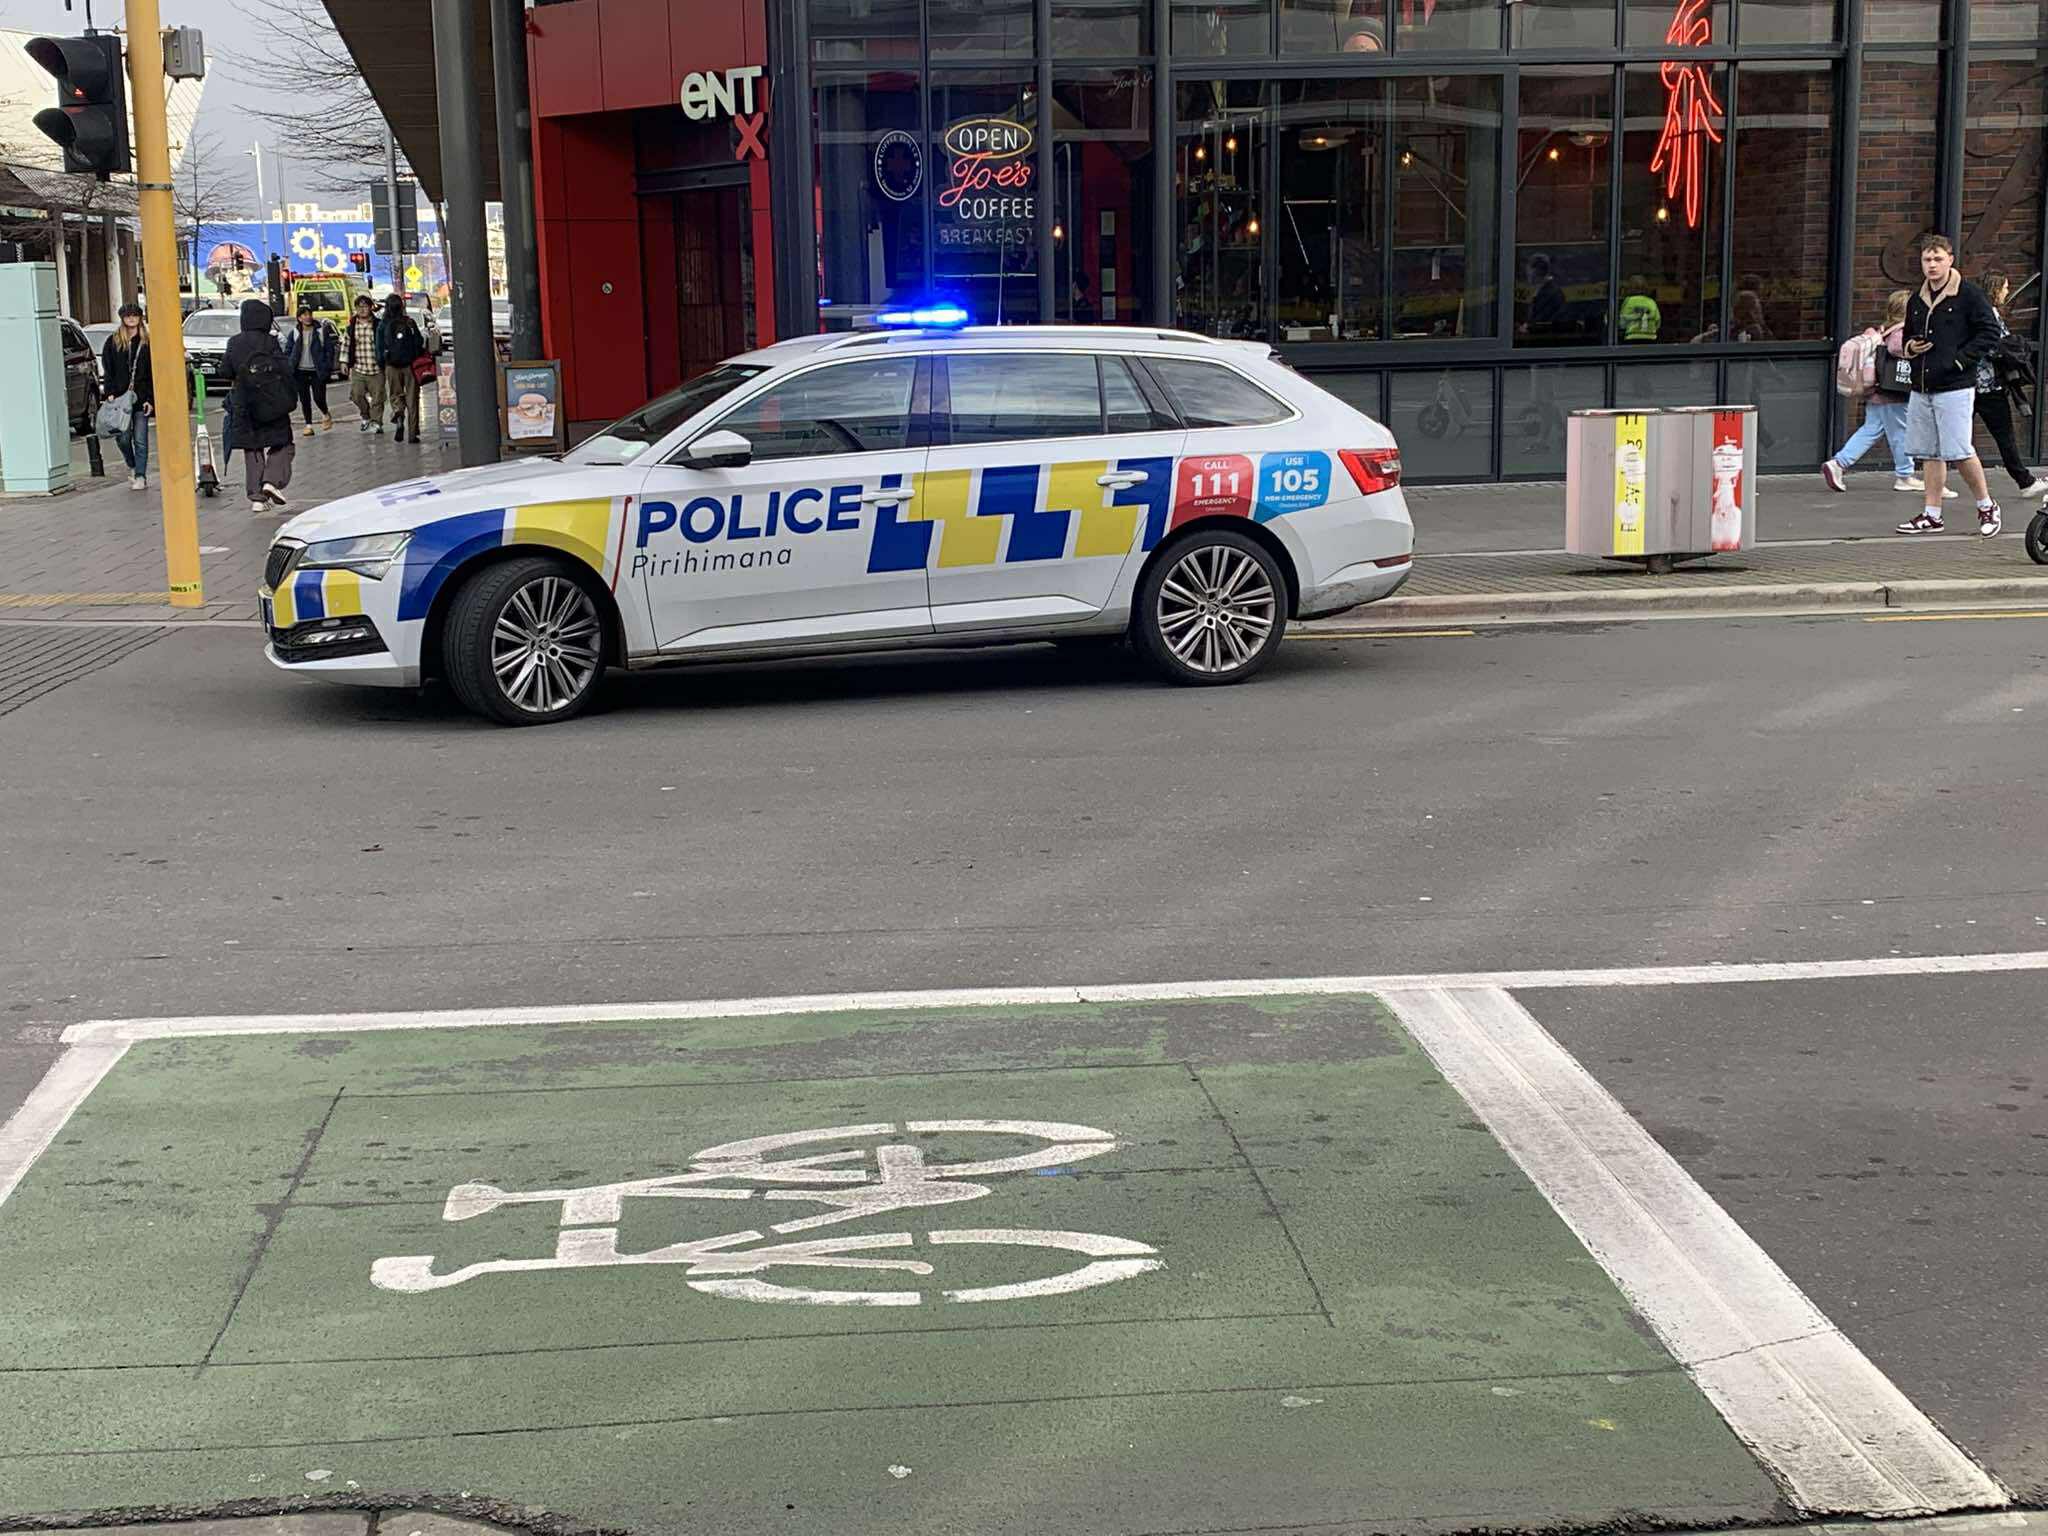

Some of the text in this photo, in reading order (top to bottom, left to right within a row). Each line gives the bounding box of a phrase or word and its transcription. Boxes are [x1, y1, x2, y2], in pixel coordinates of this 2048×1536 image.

[959, 128, 1018, 151] OPEN
[939, 151, 1031, 207] Joe's
[959, 198, 1035, 219] COFFEE
[940, 227, 1033, 245] BREAKFAST
[1204, 460, 1229, 470] CALL
[1285, 456, 1304, 466] USE
[1191, 471, 1239, 497] 111
[1271, 468, 1319, 493] 105
[1193, 497, 1238, 507] EMERGENCY
[635, 484, 864, 548] POLICE
[631, 548, 792, 579] Pirihimana
